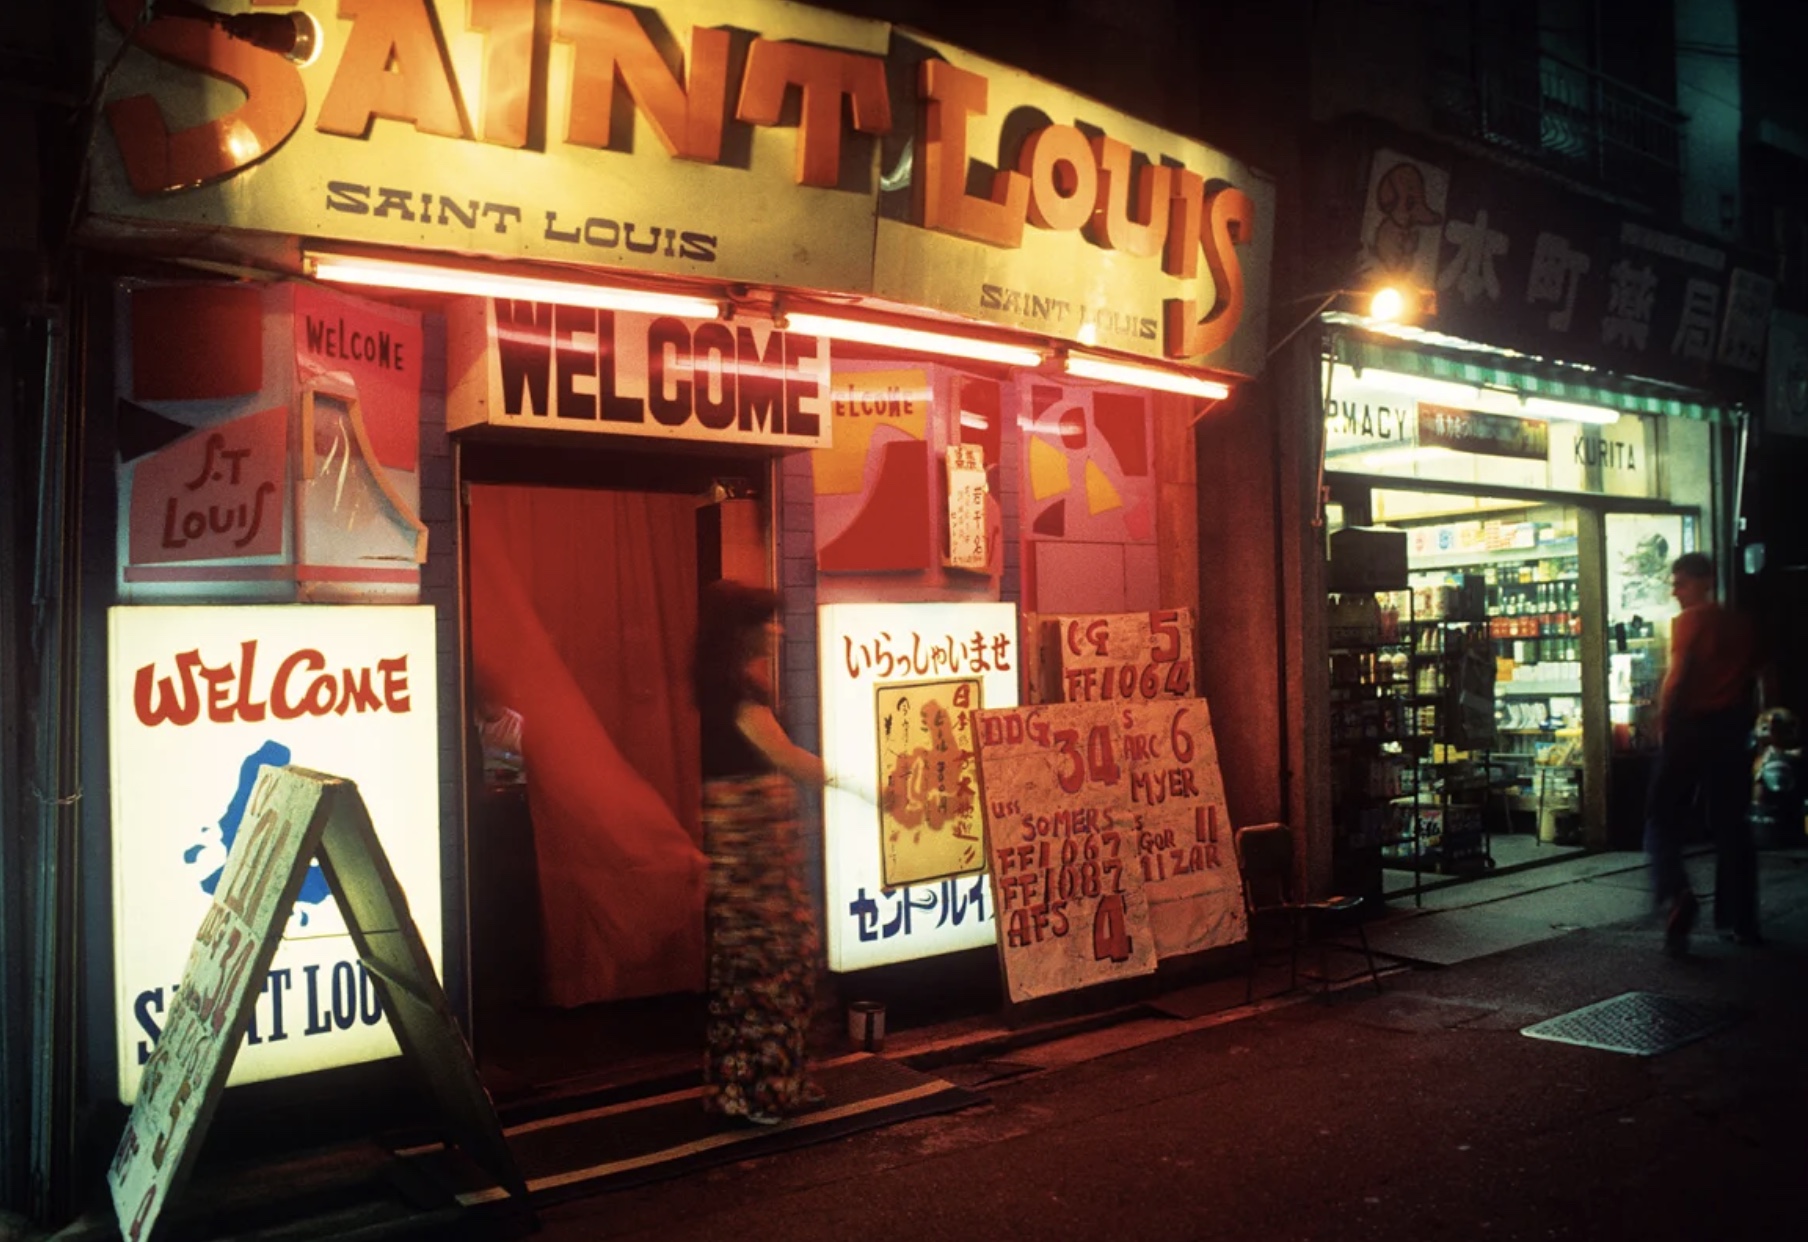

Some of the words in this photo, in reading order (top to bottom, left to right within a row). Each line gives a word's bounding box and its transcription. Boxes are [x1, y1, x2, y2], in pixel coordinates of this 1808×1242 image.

[105, 0, 892, 193] SAINT
[919, 57, 1255, 359] LOUIS
[326, 179, 521, 235] SAINT
[544, 210, 718, 263] LOUIS
[980, 282, 1070, 322] SAINT
[1080, 303, 1158, 341] LOUIS
[305, 314, 405, 372] WELCOME
[494, 296, 821, 438] WELCOME
[835, 383, 914, 418] ELCOME
[1327, 400, 1407, 442] RMACY
[1574, 430, 1637, 472] KURITA
[843, 630, 1012, 680] いらっしゃいませ
[1067, 618, 1109, 657] CG
[1149, 610, 1181, 664] 5
[133, 639, 412, 728] WELCOME
[980, 710, 1051, 749] DDG
[1053, 725, 1121, 795] 34
[1123, 733, 1162, 762] ARC
[1170, 707, 1195, 764] 6
[1131, 766, 1200, 807] MYER
[1021, 807, 1114, 842] SOMERS
[849, 876, 995, 943] セントルイ
[1007, 900, 1070, 948] AFS
[1092, 894, 1134, 963] 4
[303, 959, 385, 1037] LOU
